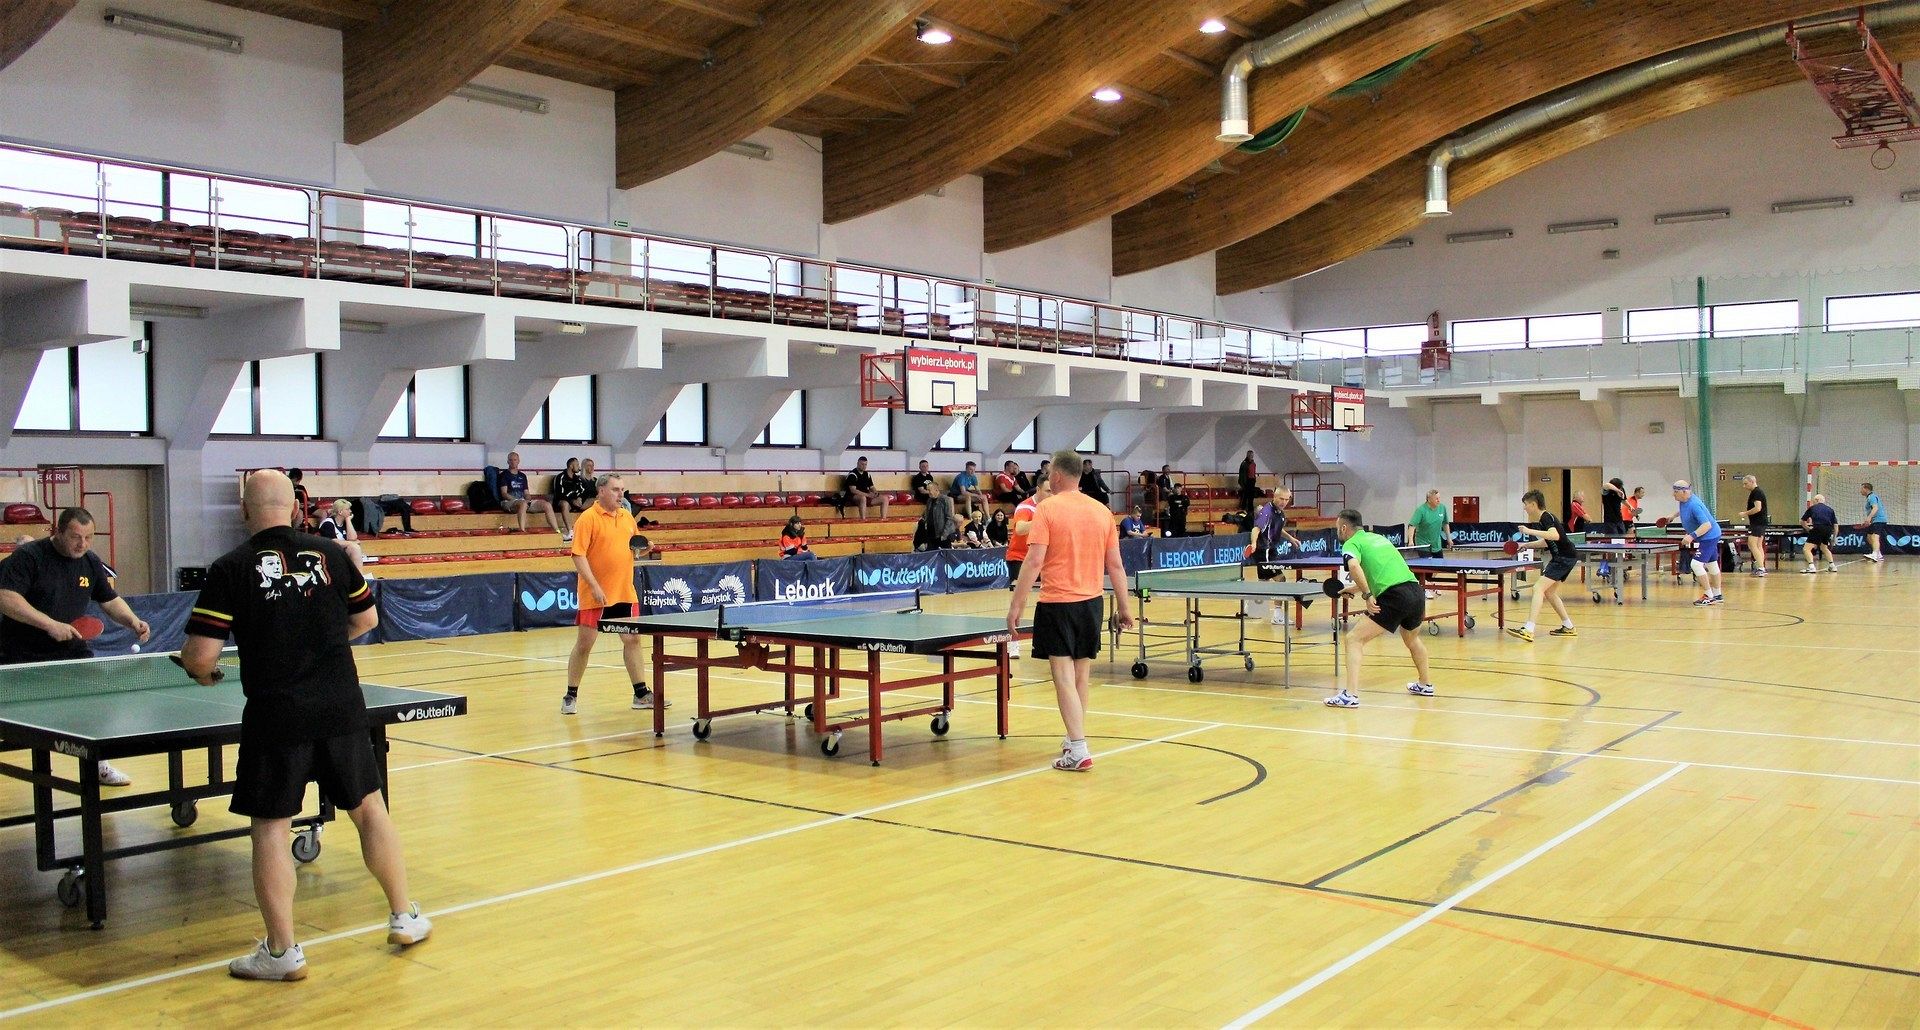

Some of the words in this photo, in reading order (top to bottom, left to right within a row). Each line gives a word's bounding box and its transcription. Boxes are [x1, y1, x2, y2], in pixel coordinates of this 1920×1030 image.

[911, 355, 975, 371] wybierzLębork.pl
[1460, 530, 1502, 542] Butterfly
[1522, 553, 1529, 561] 5
[882, 566, 936, 585] Butterfly
[416, 704, 456, 720] Butterfly
